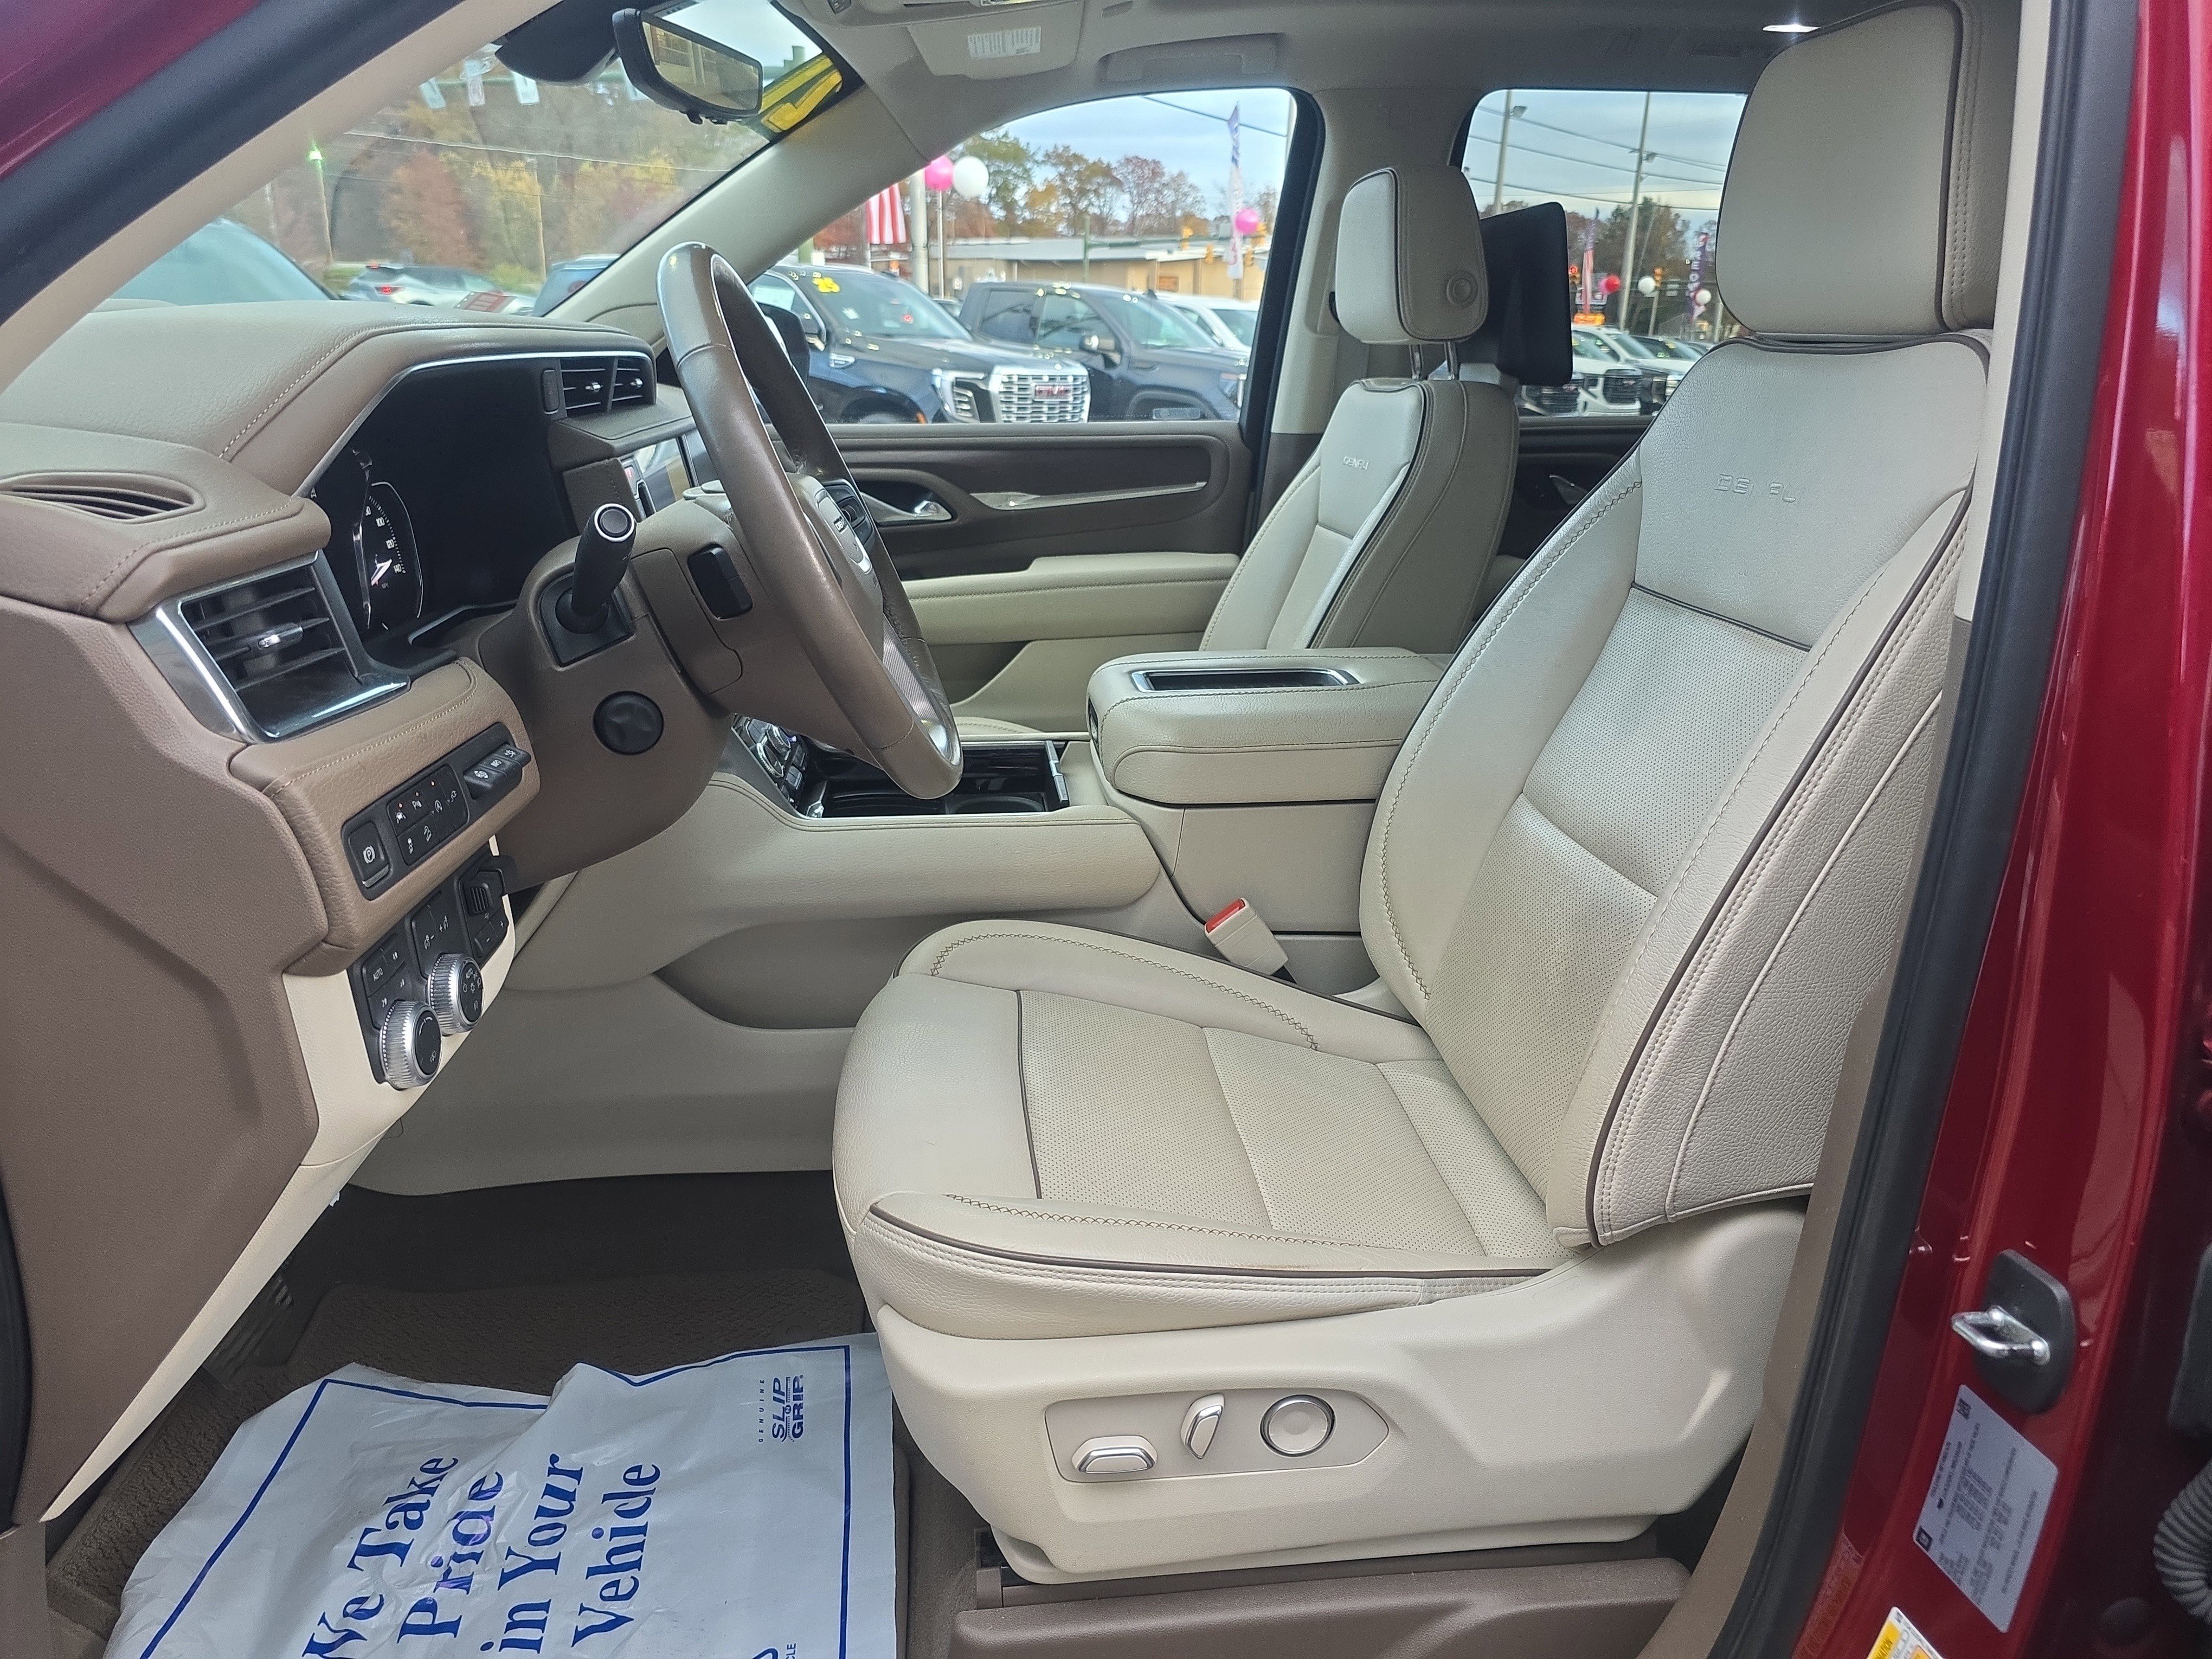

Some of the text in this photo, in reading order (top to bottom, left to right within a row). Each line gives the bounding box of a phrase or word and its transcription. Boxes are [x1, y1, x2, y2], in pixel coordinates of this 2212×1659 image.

[376, 517, 385, 527] 100
[385, 539, 395, 549] 120
[393, 563, 402, 574] 140
[373, 967, 383, 981] AUTO
[771, 1377, 786, 1438] SLIP
[347, 1457, 459, 1572] Take
[396, 1471, 504, 1644] Pride
[480, 1453, 583, 1654] in Your
[571, 1464, 661, 1648] Vehicle
